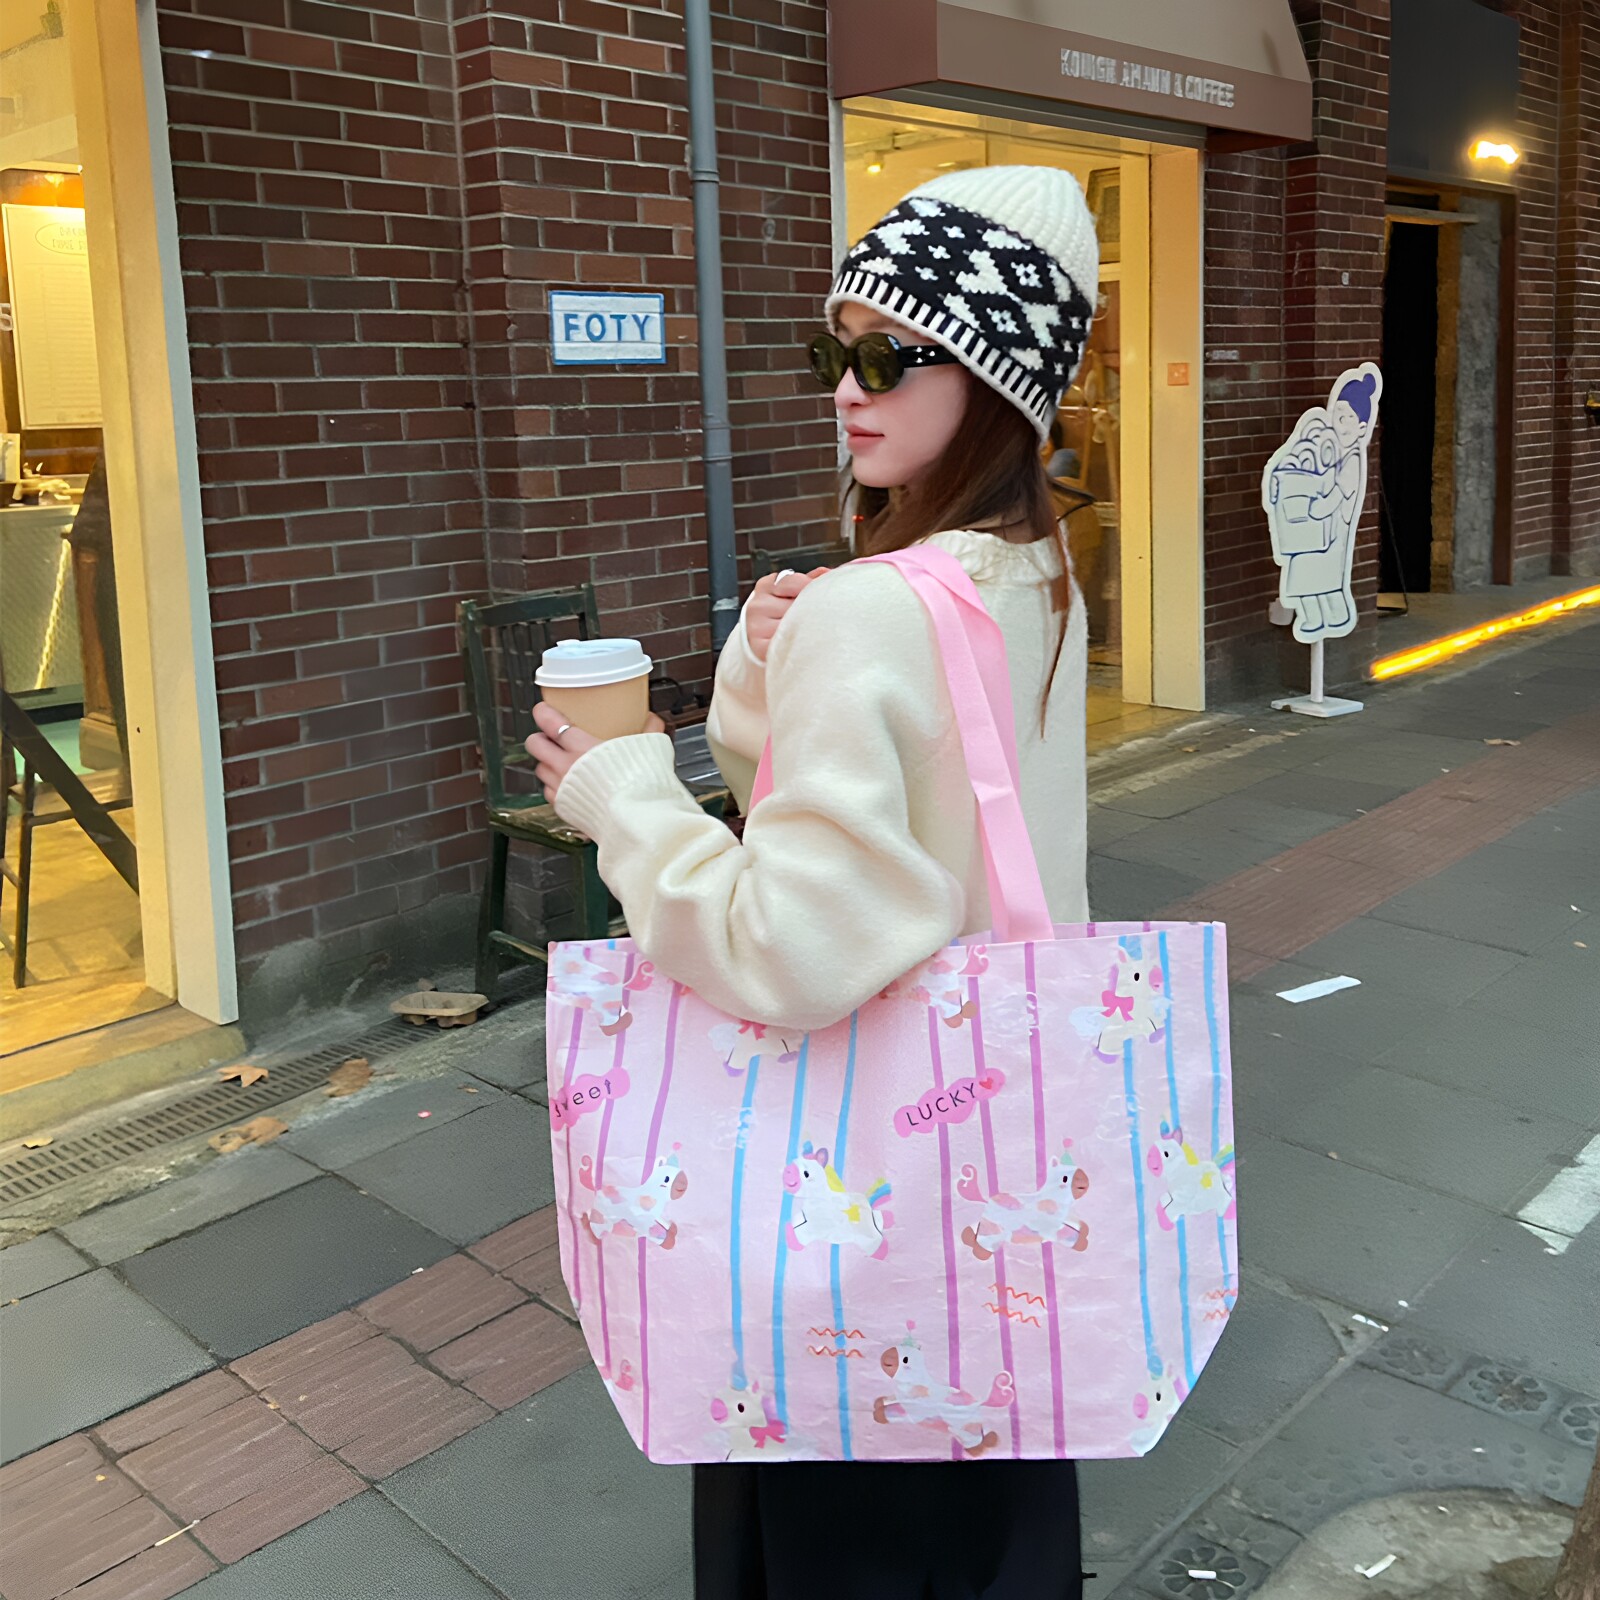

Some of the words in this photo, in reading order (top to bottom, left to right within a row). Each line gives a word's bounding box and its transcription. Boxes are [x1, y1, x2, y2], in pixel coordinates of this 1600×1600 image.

[1185, 75, 1235, 108] COFFEE
[563, 313, 650, 343] FOTY
[906, 1082, 975, 1126] LUCKY
